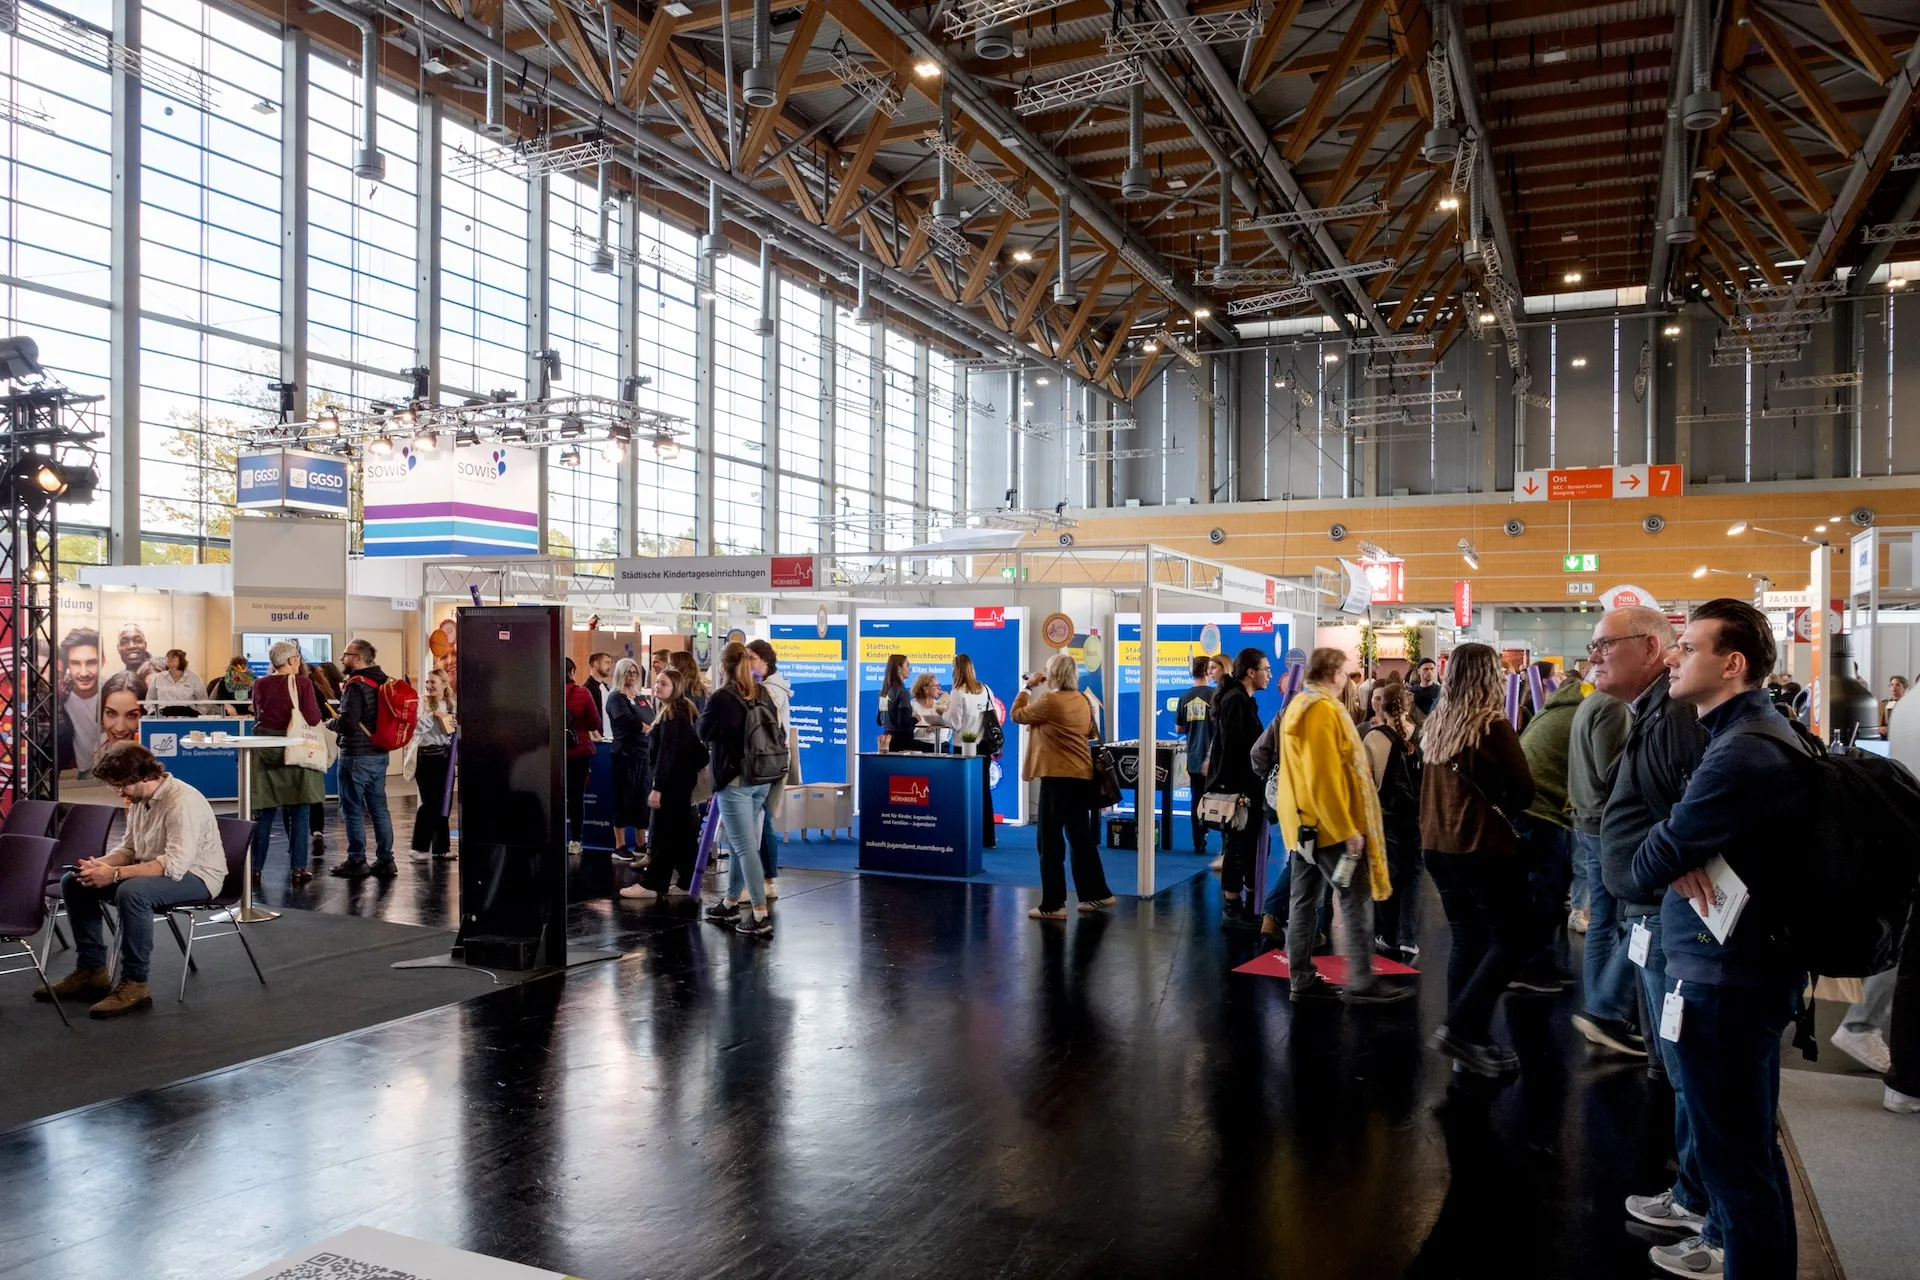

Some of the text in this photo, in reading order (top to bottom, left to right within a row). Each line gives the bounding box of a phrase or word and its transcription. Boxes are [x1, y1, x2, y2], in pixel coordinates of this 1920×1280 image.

[254, 468, 280, 482] GGSD
[1552, 475, 1567, 483] Ost
[308, 472, 343, 488] GGSD
[1659, 469, 1671, 491] 7
[621, 569, 766, 580] Städtische Kindertageseinrichtungen
[772, 578, 801, 586] NÜRNBERG
[1768, 595, 1807, 603] 7A-518.8
[270, 611, 309, 622] ggsd.de
[911, 666, 928, 674] Kitas
[928, 665, 946, 674] leben
[193, 749, 235, 757] Gemeinnützige
[890, 795, 918, 803] NÜRNBERG
